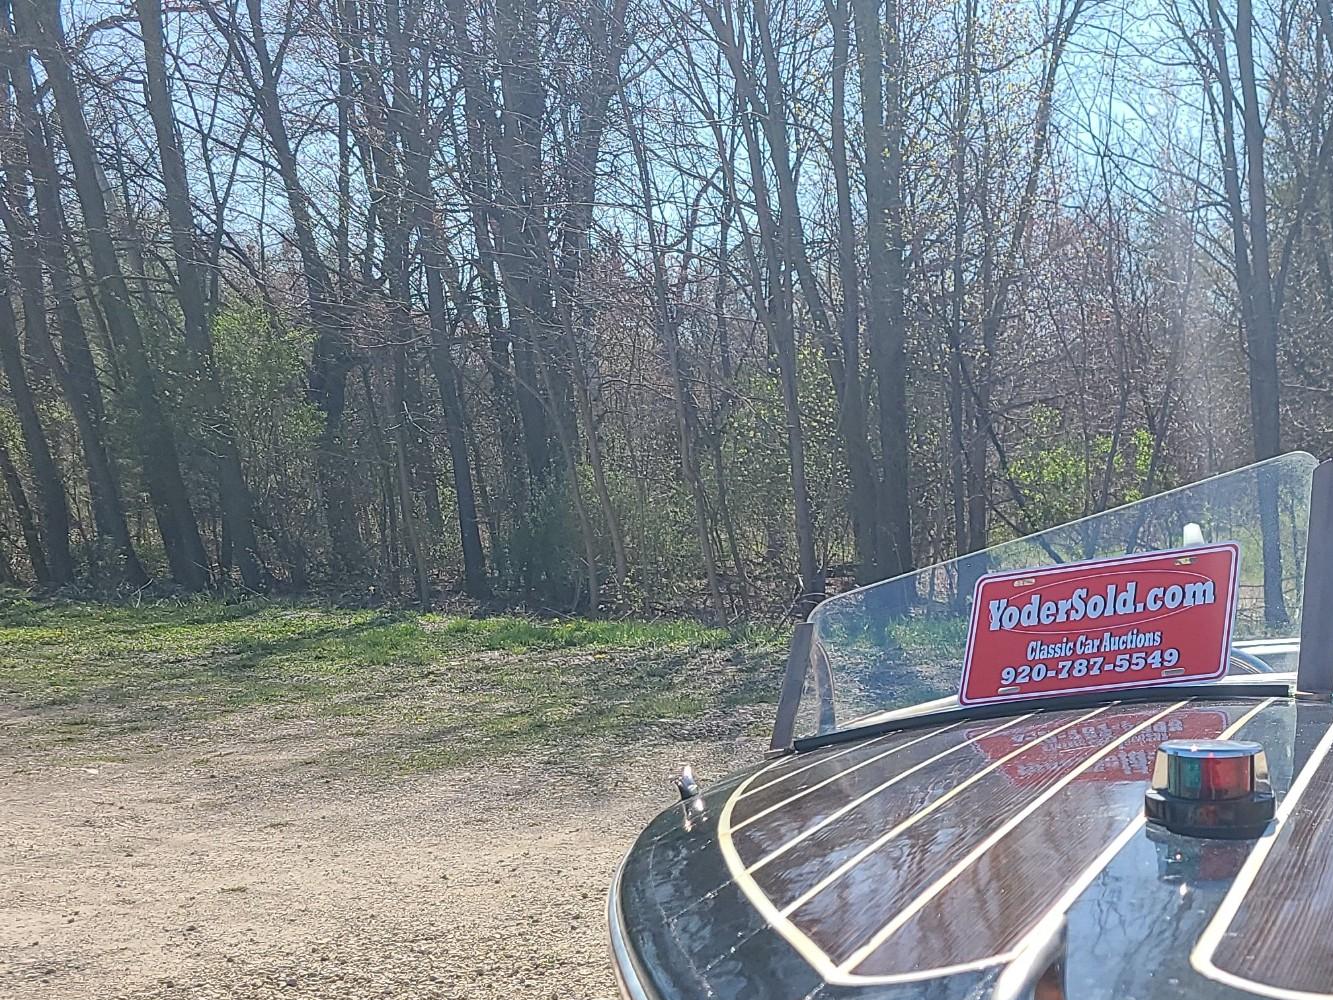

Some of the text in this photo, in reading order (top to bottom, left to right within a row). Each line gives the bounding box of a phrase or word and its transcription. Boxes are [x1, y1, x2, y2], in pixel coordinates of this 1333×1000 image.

[988, 578, 1216, 632] YoderSold.com
[1026, 628, 1162, 661] Classic Car Auctions
[1001, 648, 1180, 685] 920-787-5549
